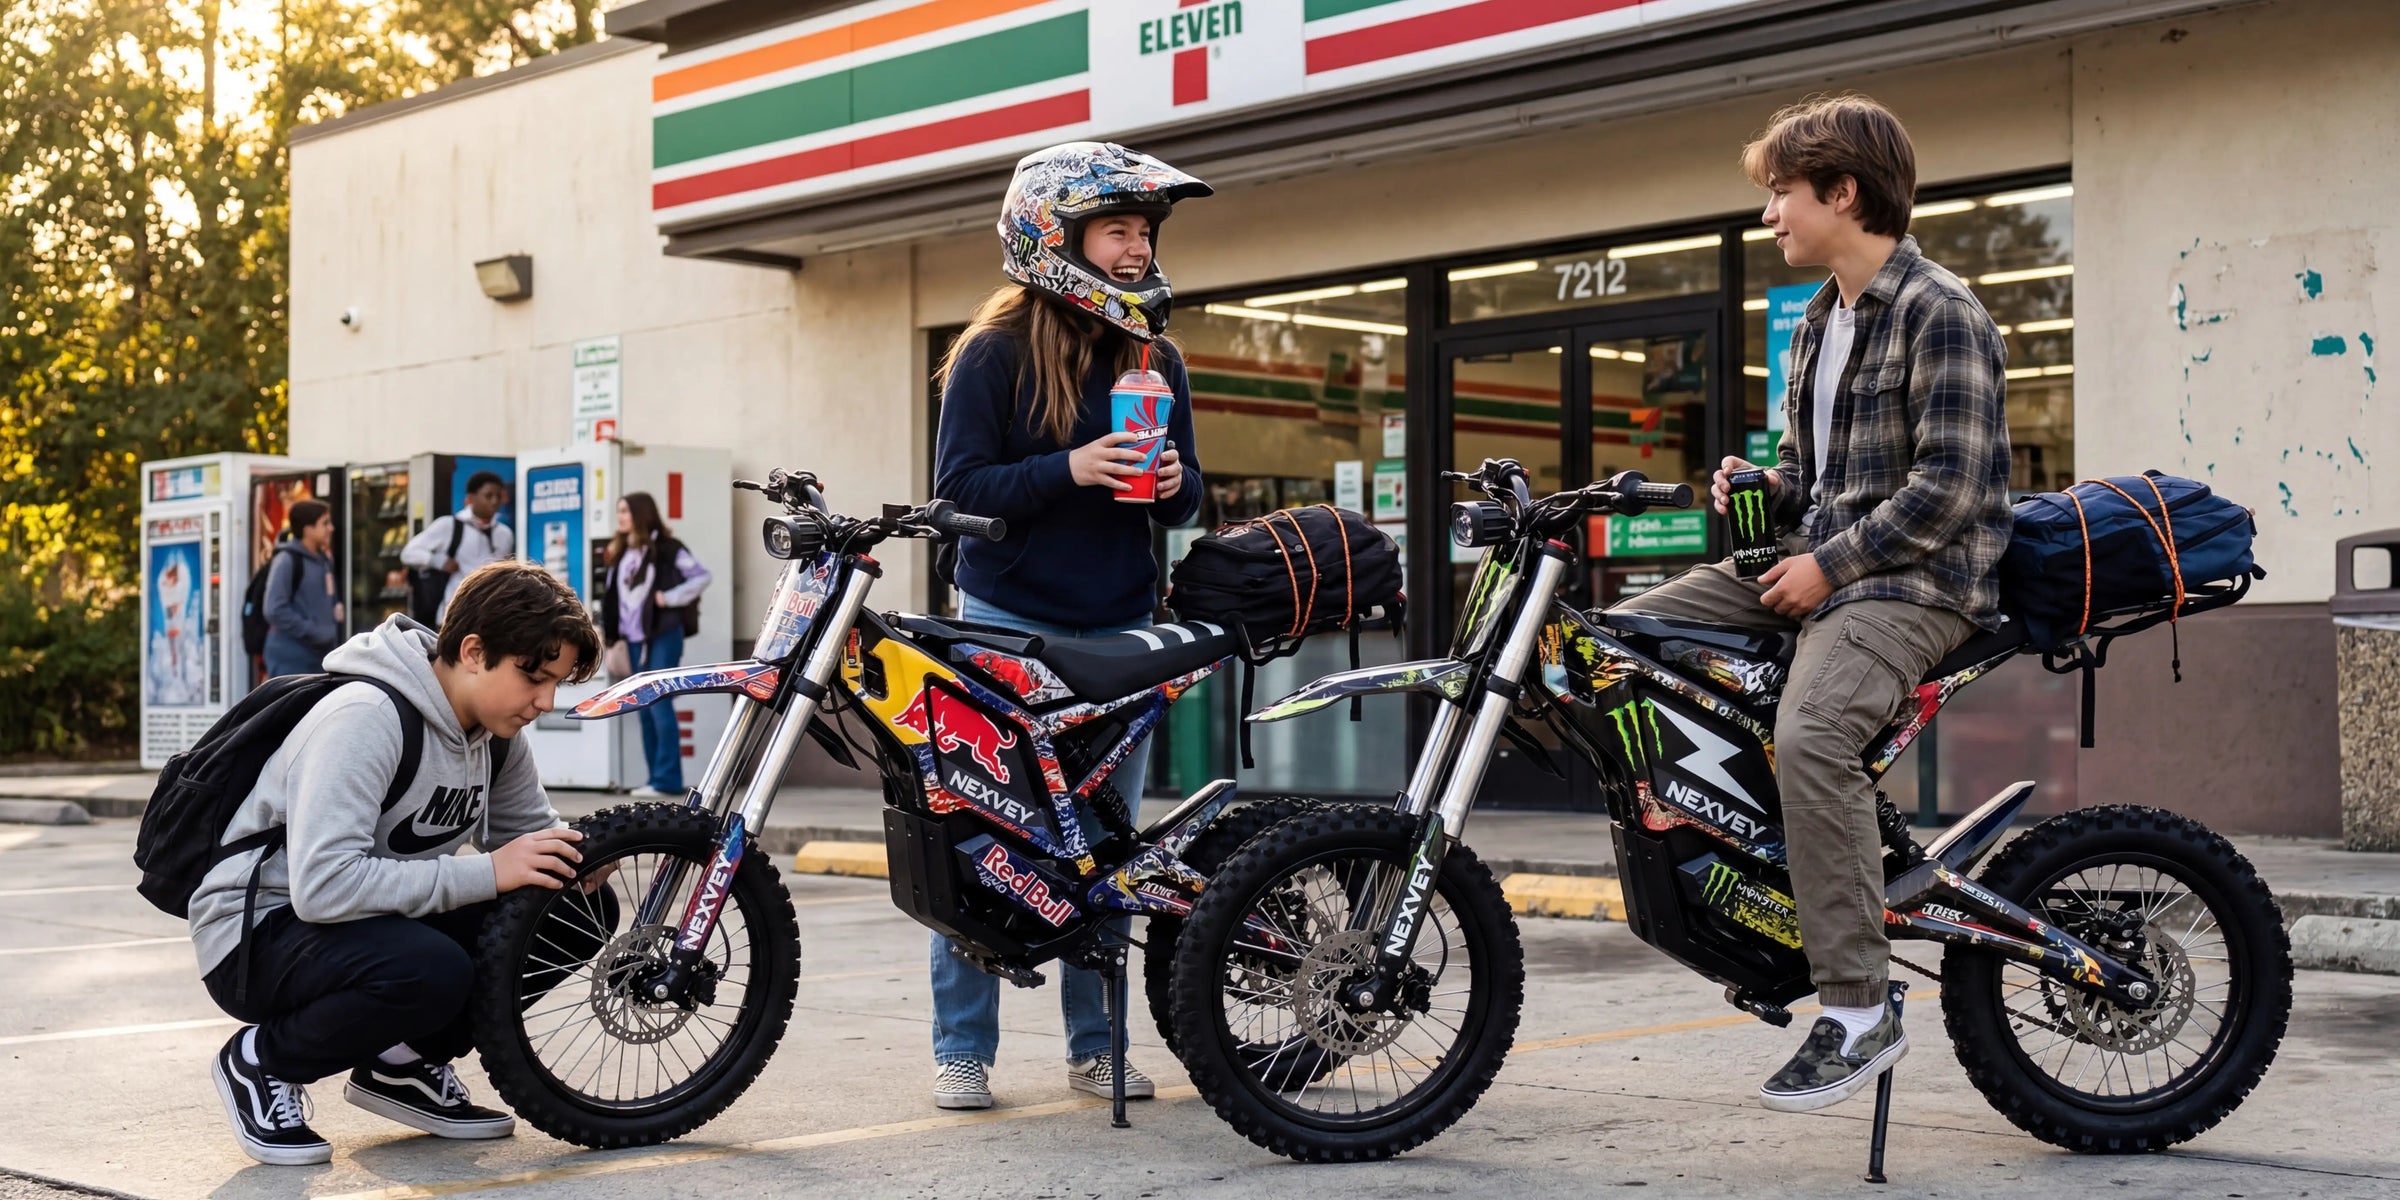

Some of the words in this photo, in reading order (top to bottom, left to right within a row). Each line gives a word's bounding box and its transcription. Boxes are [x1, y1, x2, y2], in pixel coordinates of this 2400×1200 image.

[1553, 257, 1627, 301] 7212
[416, 784, 484, 828] NIKE
[949, 769, 1035, 825] NEXVEY
[1665, 780, 1767, 840] NEXVEY
[682, 852, 732, 952] NEXVEY
[981, 843, 1037, 895] Red
[1023, 878, 1075, 928] Bull
[1385, 854, 1434, 957] NEXVEY
[1736, 882, 1789, 919] MONSTER
